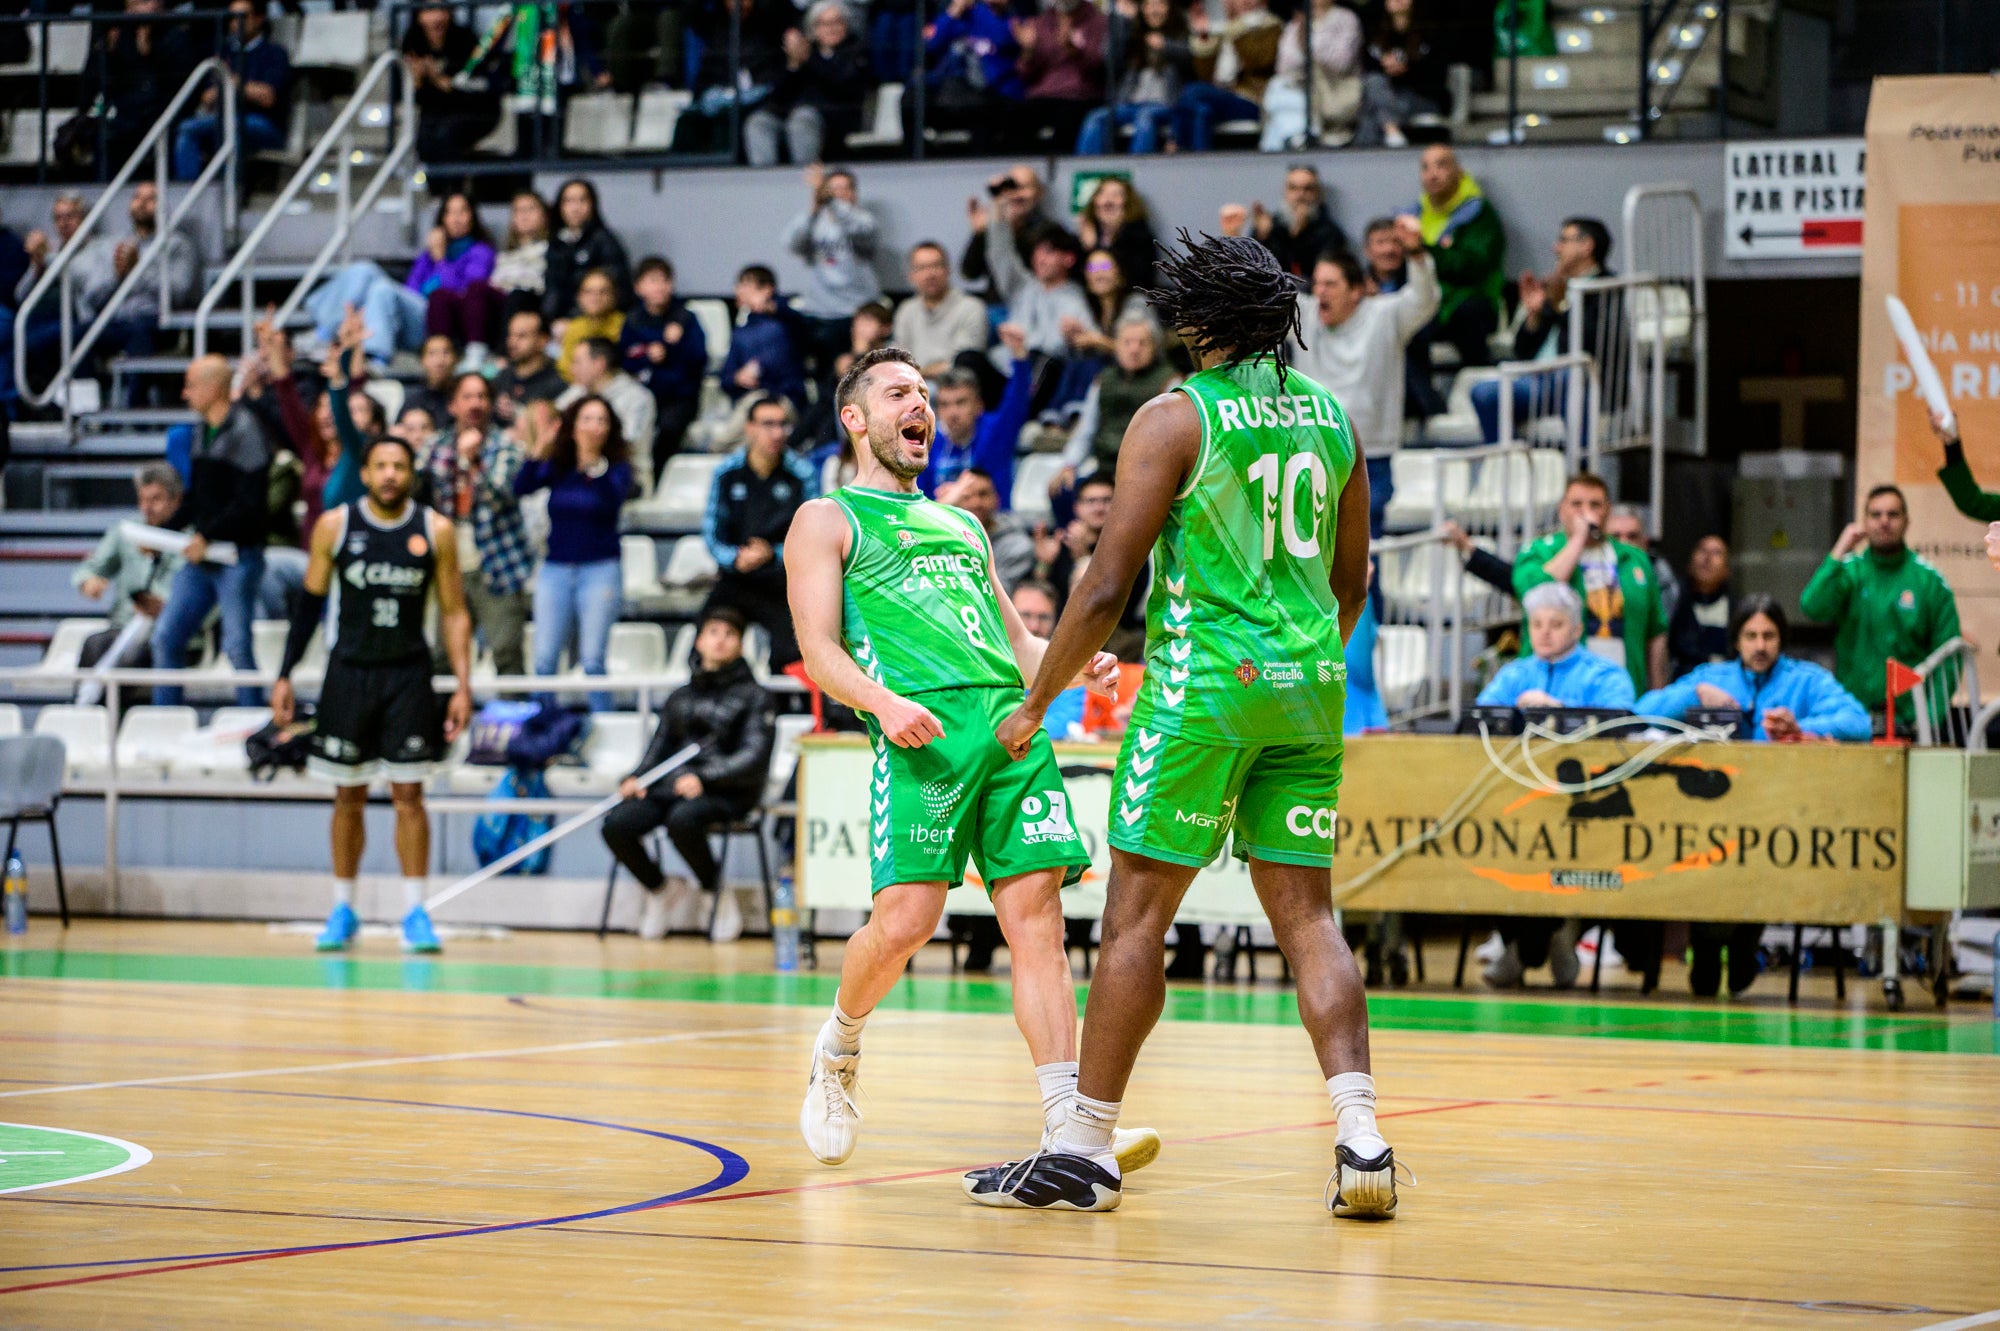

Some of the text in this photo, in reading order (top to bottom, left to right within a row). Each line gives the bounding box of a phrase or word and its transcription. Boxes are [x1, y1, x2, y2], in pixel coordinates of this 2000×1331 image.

[1733, 151, 1838, 178] LATERAL
[1736, 187, 1784, 213] PAR
[1216, 394, 1341, 432] RUSSELL
[1247, 451, 1328, 561] 10
[910, 553, 985, 578] AMICS
[960, 605, 987, 649] 8
[1263, 668, 1304, 681] Castelló
[1334, 815, 1898, 871] PATRONAT D'ESPORTS
